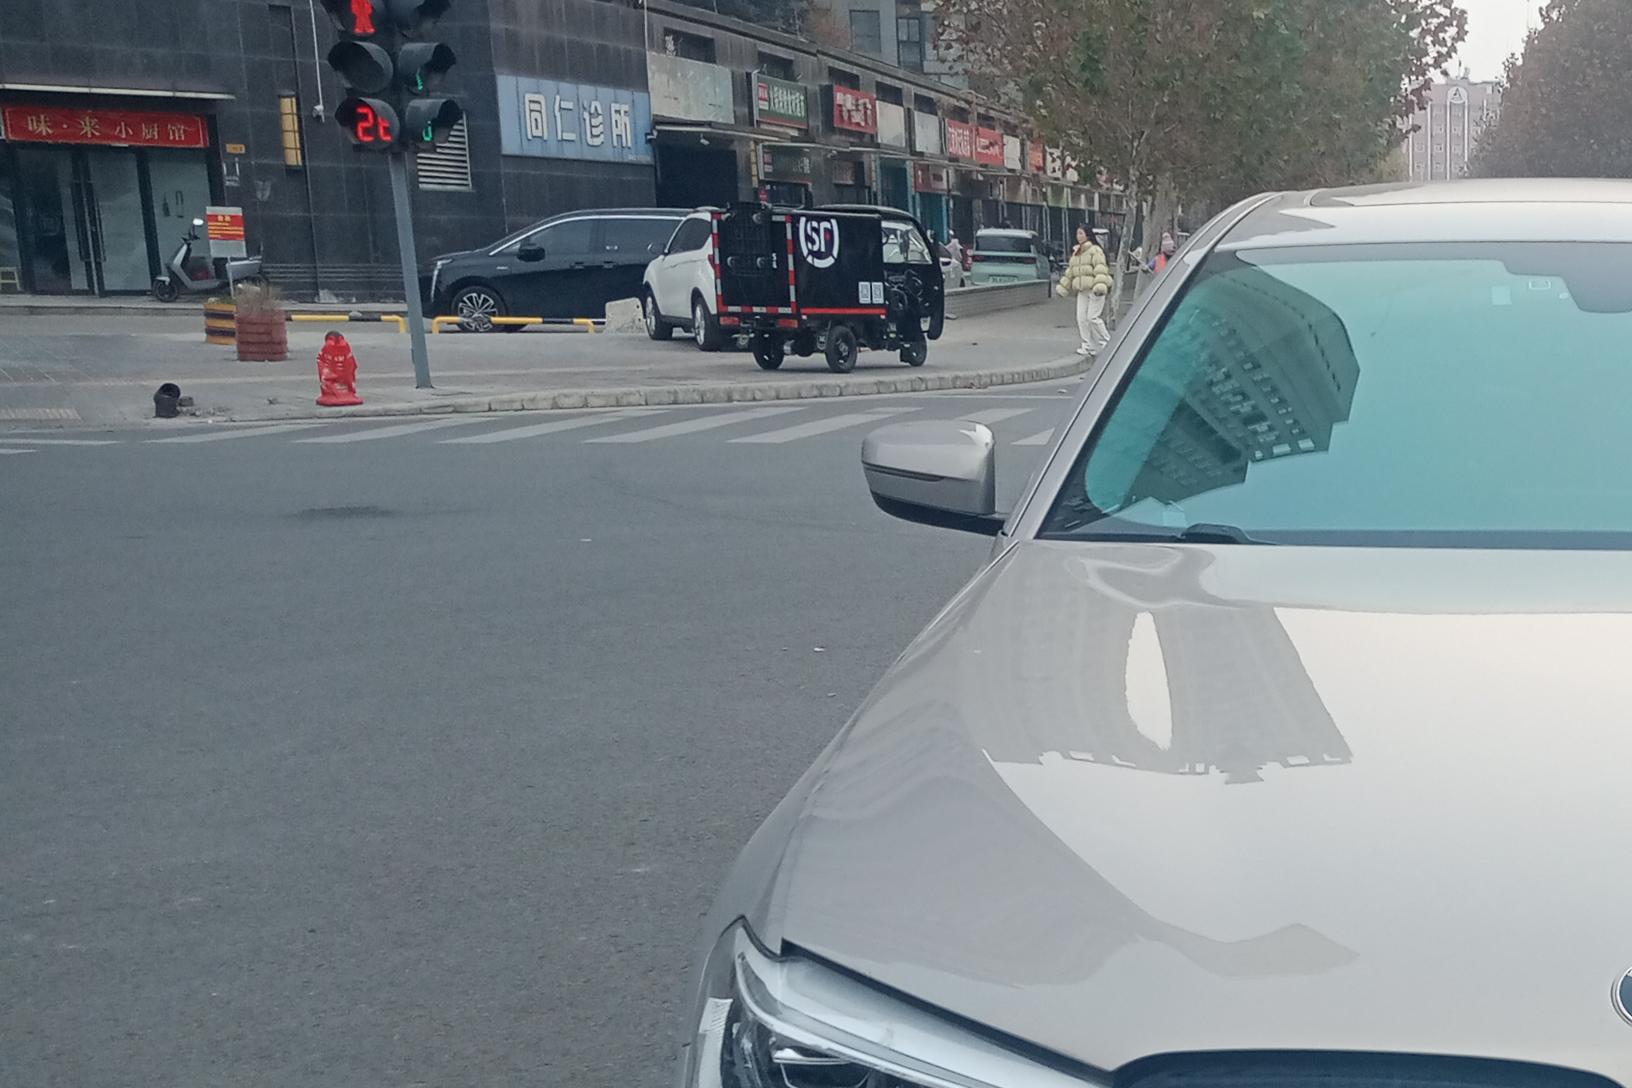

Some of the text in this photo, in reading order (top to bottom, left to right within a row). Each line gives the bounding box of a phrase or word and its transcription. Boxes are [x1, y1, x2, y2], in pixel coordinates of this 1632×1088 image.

[524, 92, 632, 149] 同仁诊所
[806, 220, 832, 252] SF
